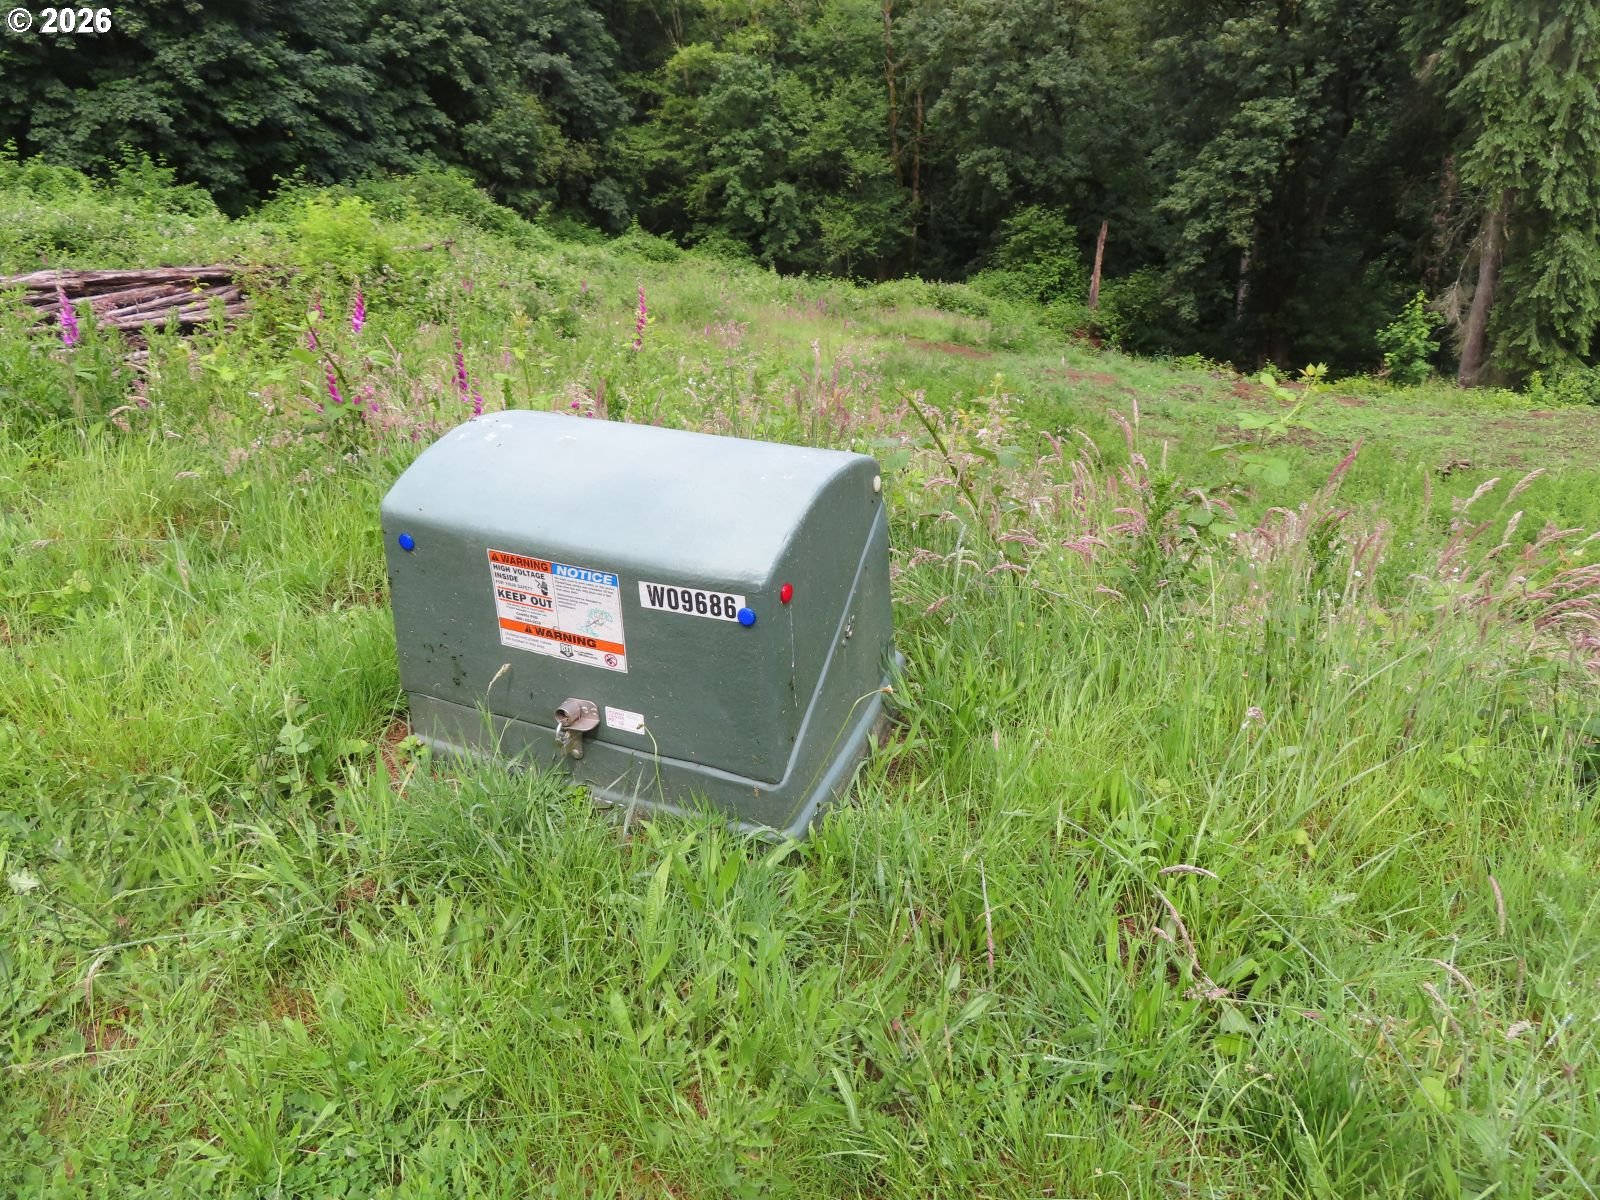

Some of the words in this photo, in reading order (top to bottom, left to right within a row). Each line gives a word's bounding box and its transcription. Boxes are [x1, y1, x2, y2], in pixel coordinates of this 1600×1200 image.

[493, 564, 511, 573] HIGH
[512, 568, 545, 580] VOLTAGE
[500, 554, 549, 571] WARNING
[494, 572, 519, 582] INSIDE
[556, 565, 613, 585] NOTICE
[497, 589, 527, 602] KEEP
[530, 596, 553, 608] OUT
[646, 584, 737, 619] W09686
[534, 626, 597, 648] WARNING
